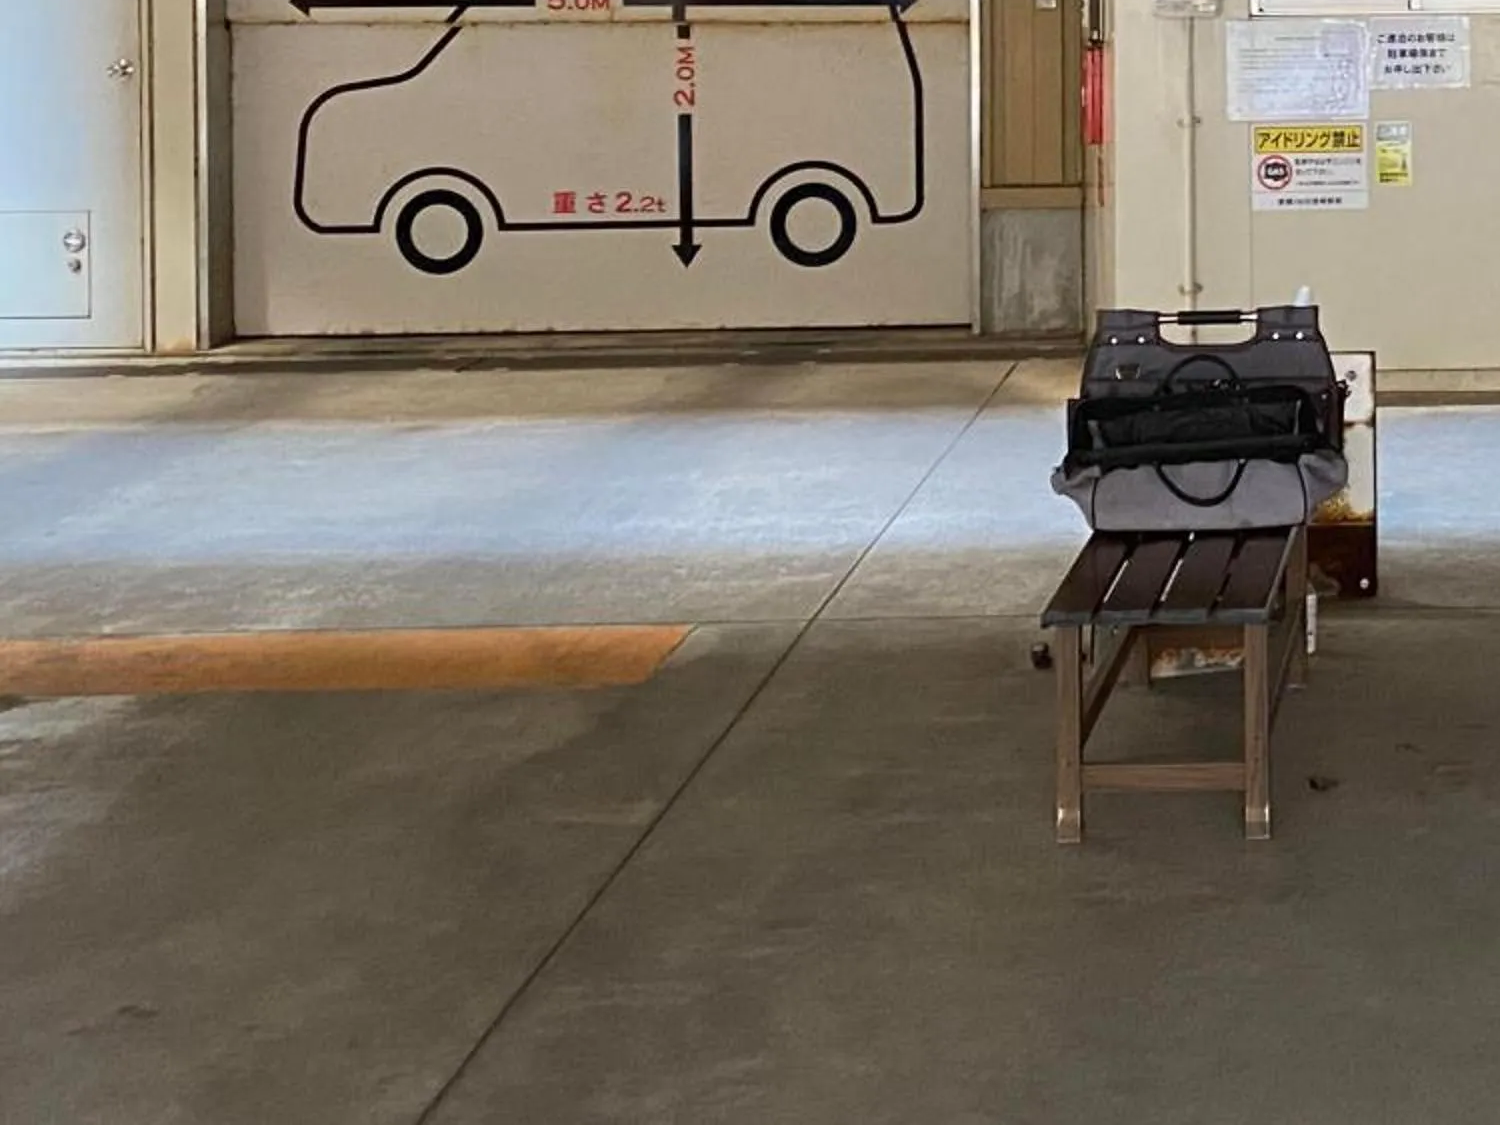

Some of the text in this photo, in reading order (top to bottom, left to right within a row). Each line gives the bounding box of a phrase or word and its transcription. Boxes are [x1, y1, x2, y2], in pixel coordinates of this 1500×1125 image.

[673, 46, 696, 107] 2.0M
[1256, 129, 1361, 149] アイドリング禁止
